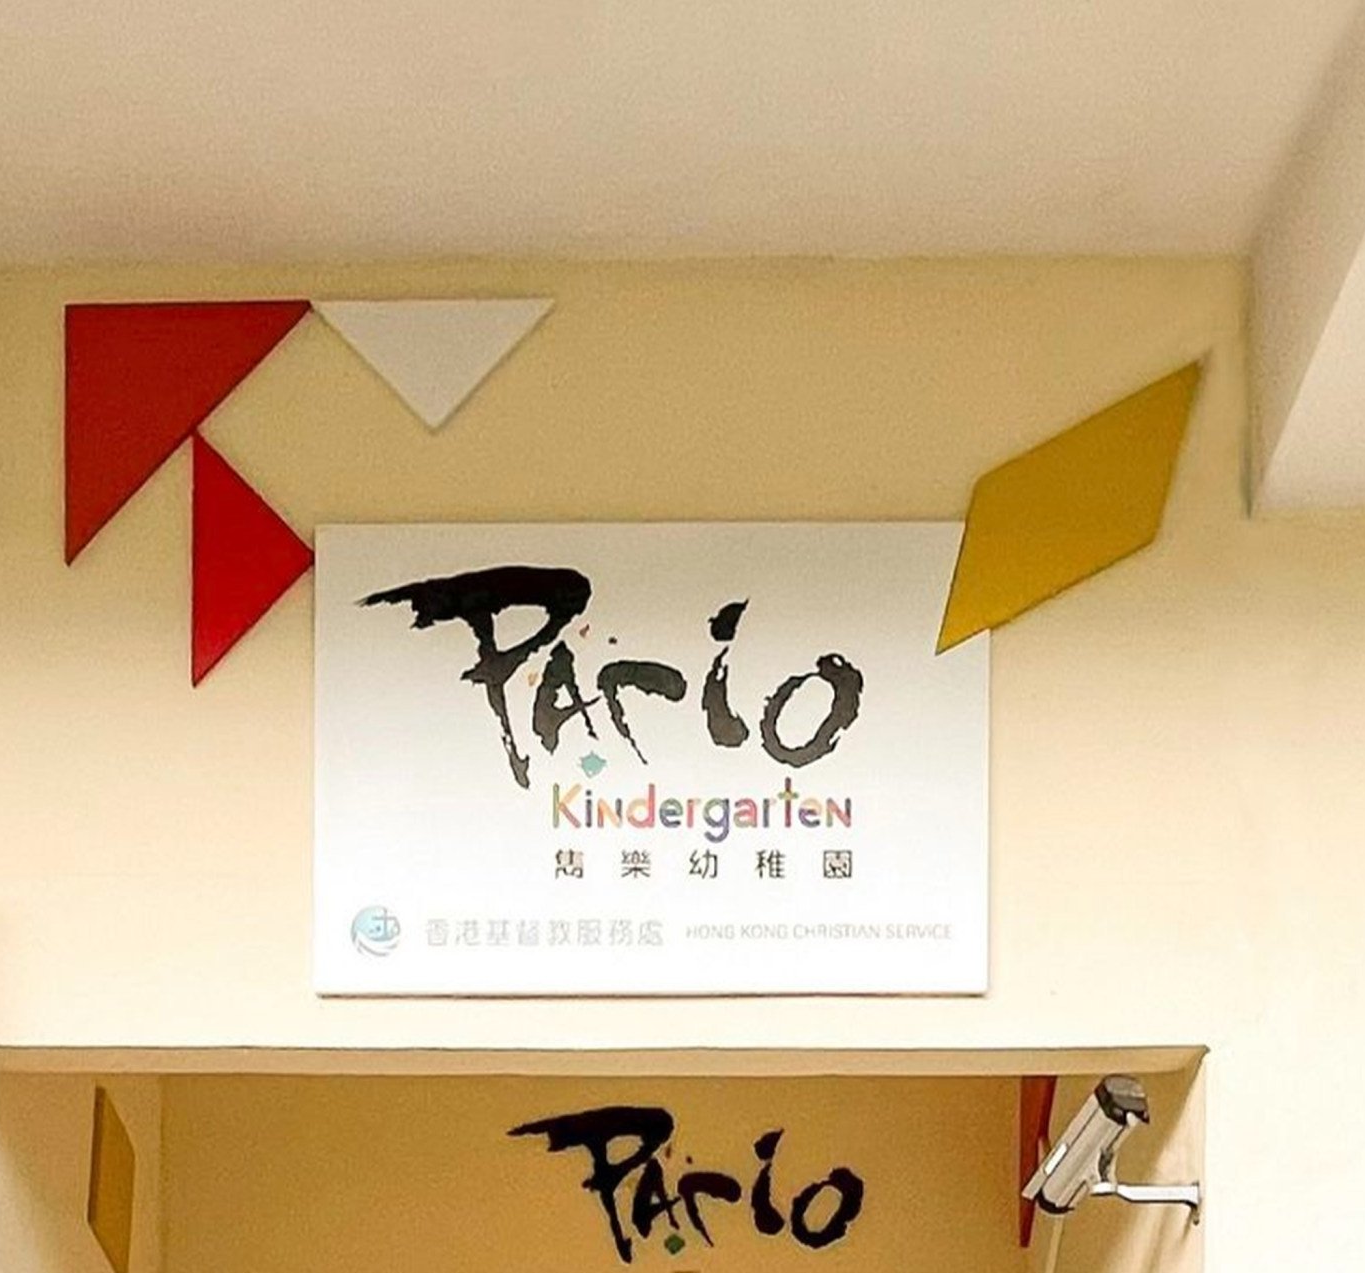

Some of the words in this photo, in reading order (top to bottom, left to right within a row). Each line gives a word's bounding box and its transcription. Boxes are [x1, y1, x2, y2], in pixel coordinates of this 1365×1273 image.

[555, 849, 853, 879] 雋樂幼稚園
[426, 918, 664, 947] 香港基督教服務處
[685, 923, 736, 940] HONG
[740, 923, 789, 940] KONG
[792, 923, 881, 940] CHRISTIAN
[885, 923, 953, 940] SERVICE
